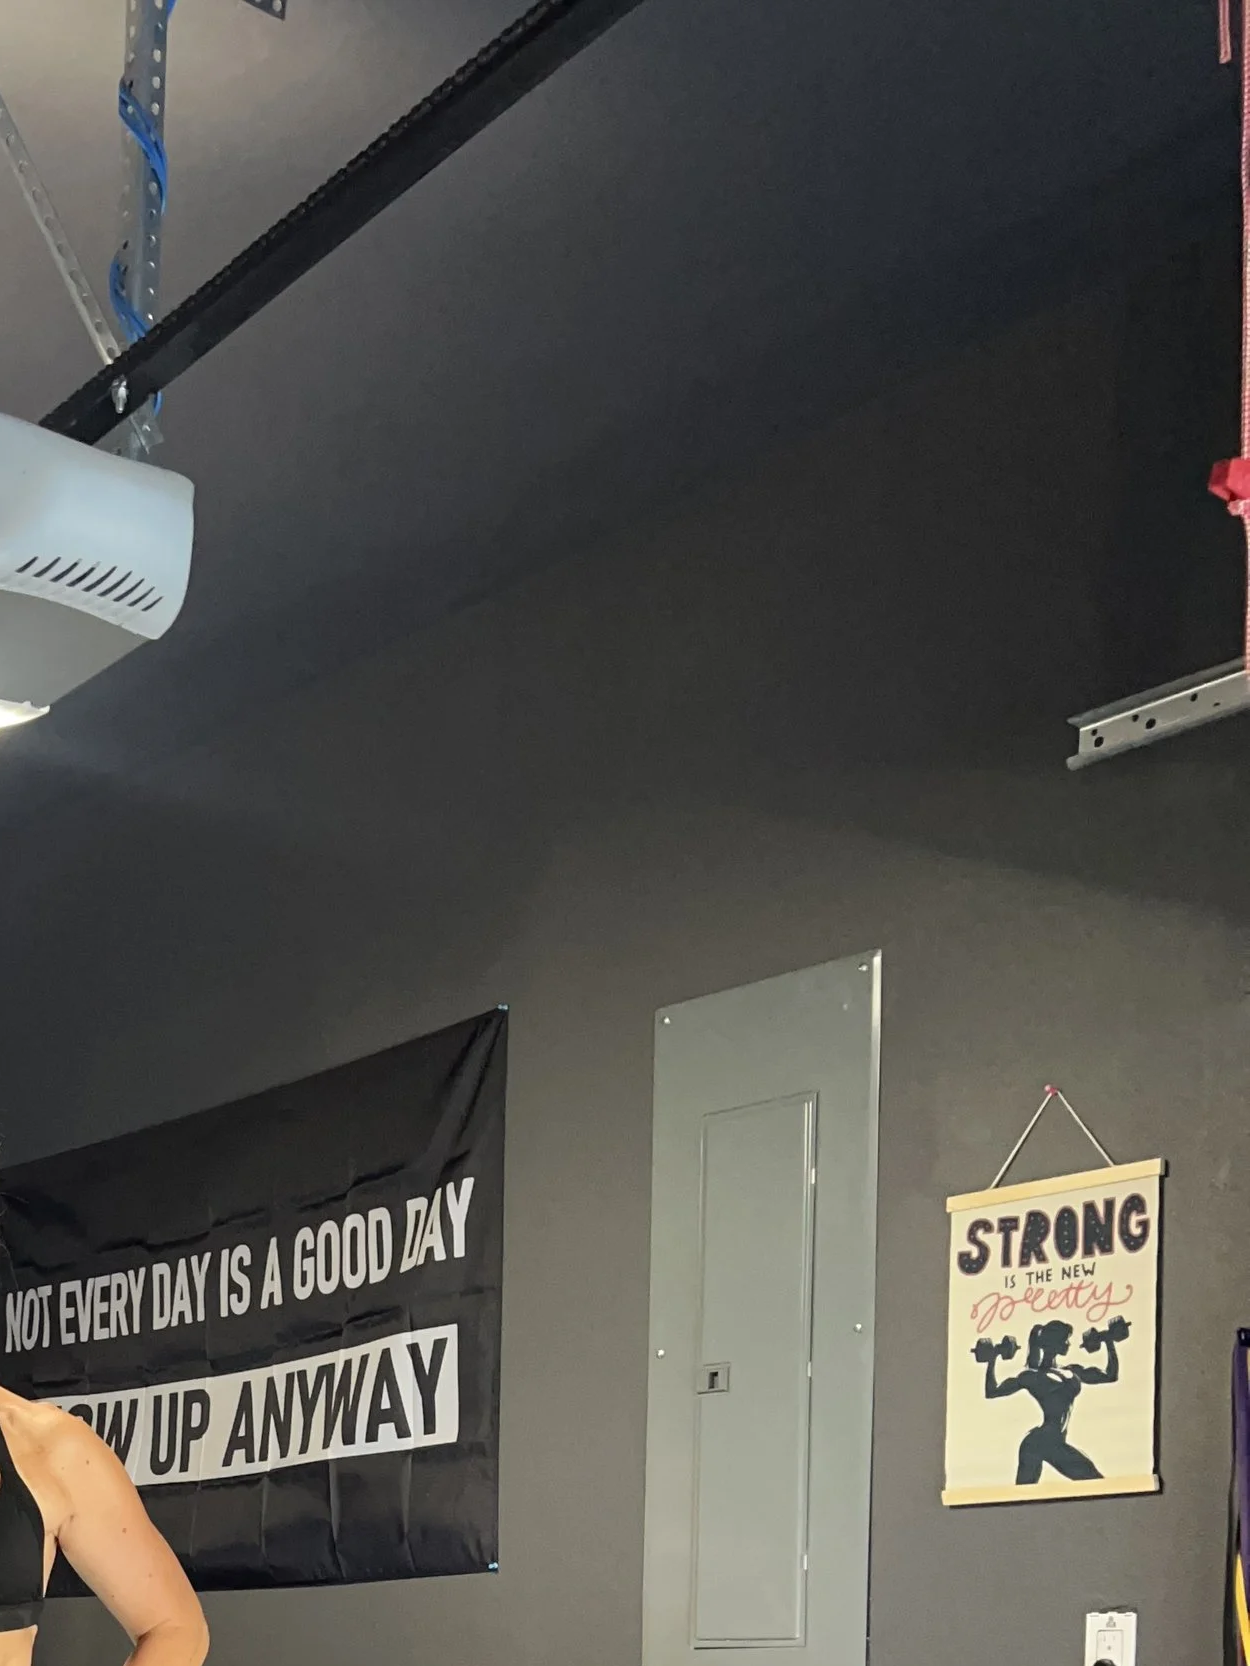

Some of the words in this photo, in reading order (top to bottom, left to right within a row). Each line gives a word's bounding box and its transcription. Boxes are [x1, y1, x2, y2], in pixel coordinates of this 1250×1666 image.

[5, 1284, 53, 1353] NOT
[59, 1266, 146, 1345] EVERY
[152, 1251, 212, 1331] DAY
[219, 1245, 252, 1318] IS
[260, 1237, 283, 1310] A
[292, 1206, 393, 1301] GOOD
[399, 1176, 475, 1274] DAY
[957, 1193, 1150, 1276] STRONG
[1004, 1275, 1016, 1289] IS
[1026, 1268, 1053, 1286] THE
[1061, 1262, 1096, 1281] NEW
[970, 1279, 1134, 1334] pretty
[149, 1389, 211, 1476] UP
[221, 1337, 448, 1468] ANYWAY
